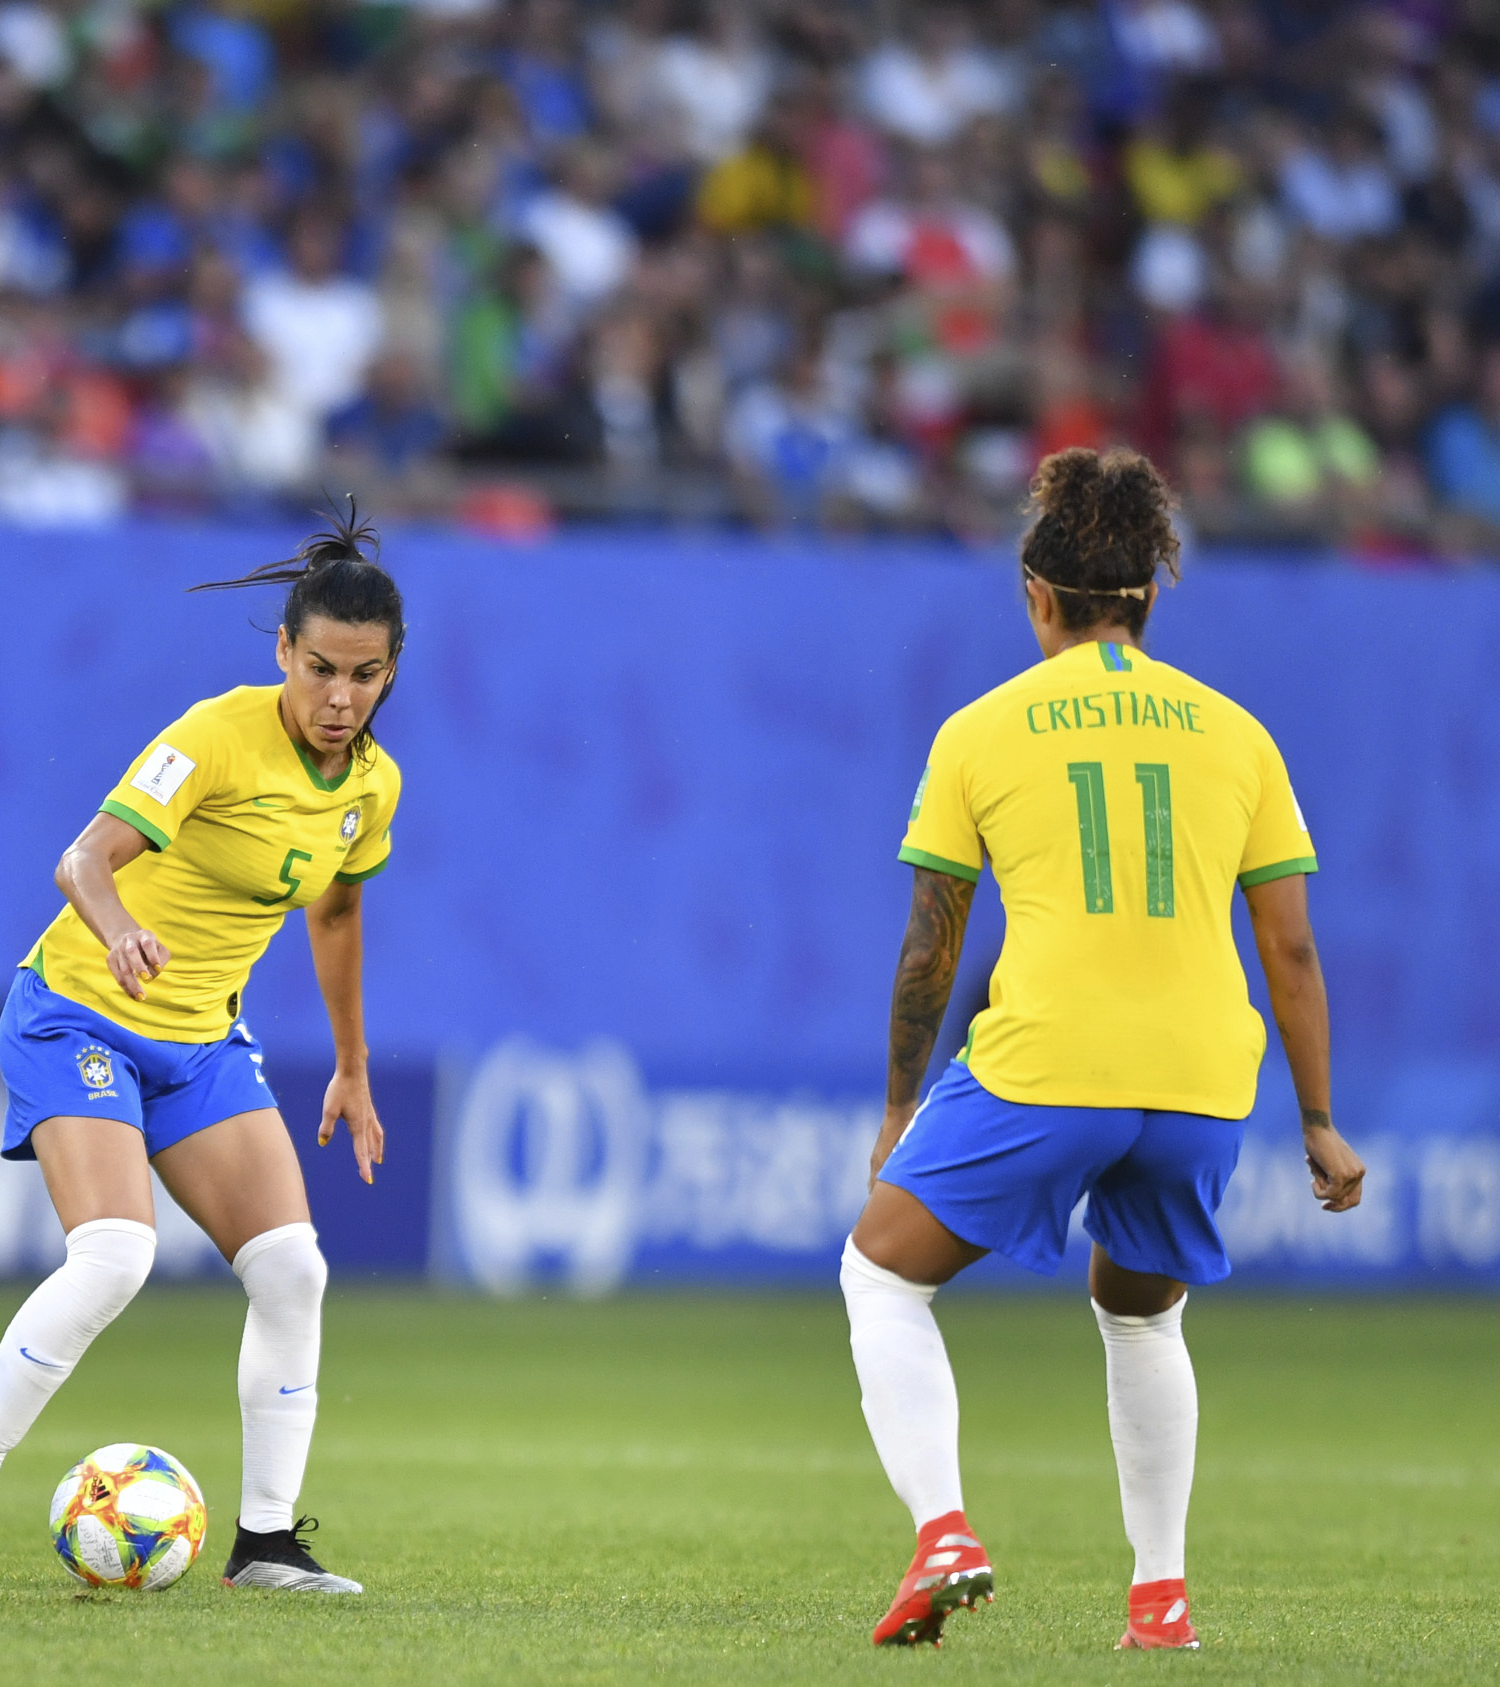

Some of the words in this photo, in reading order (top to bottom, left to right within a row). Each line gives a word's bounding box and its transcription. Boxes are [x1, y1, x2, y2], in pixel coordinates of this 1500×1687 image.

[1026, 691, 1205, 735] CRISTIANE
[1067, 761, 1175, 918] 11
[251, 848, 312, 907] 5
